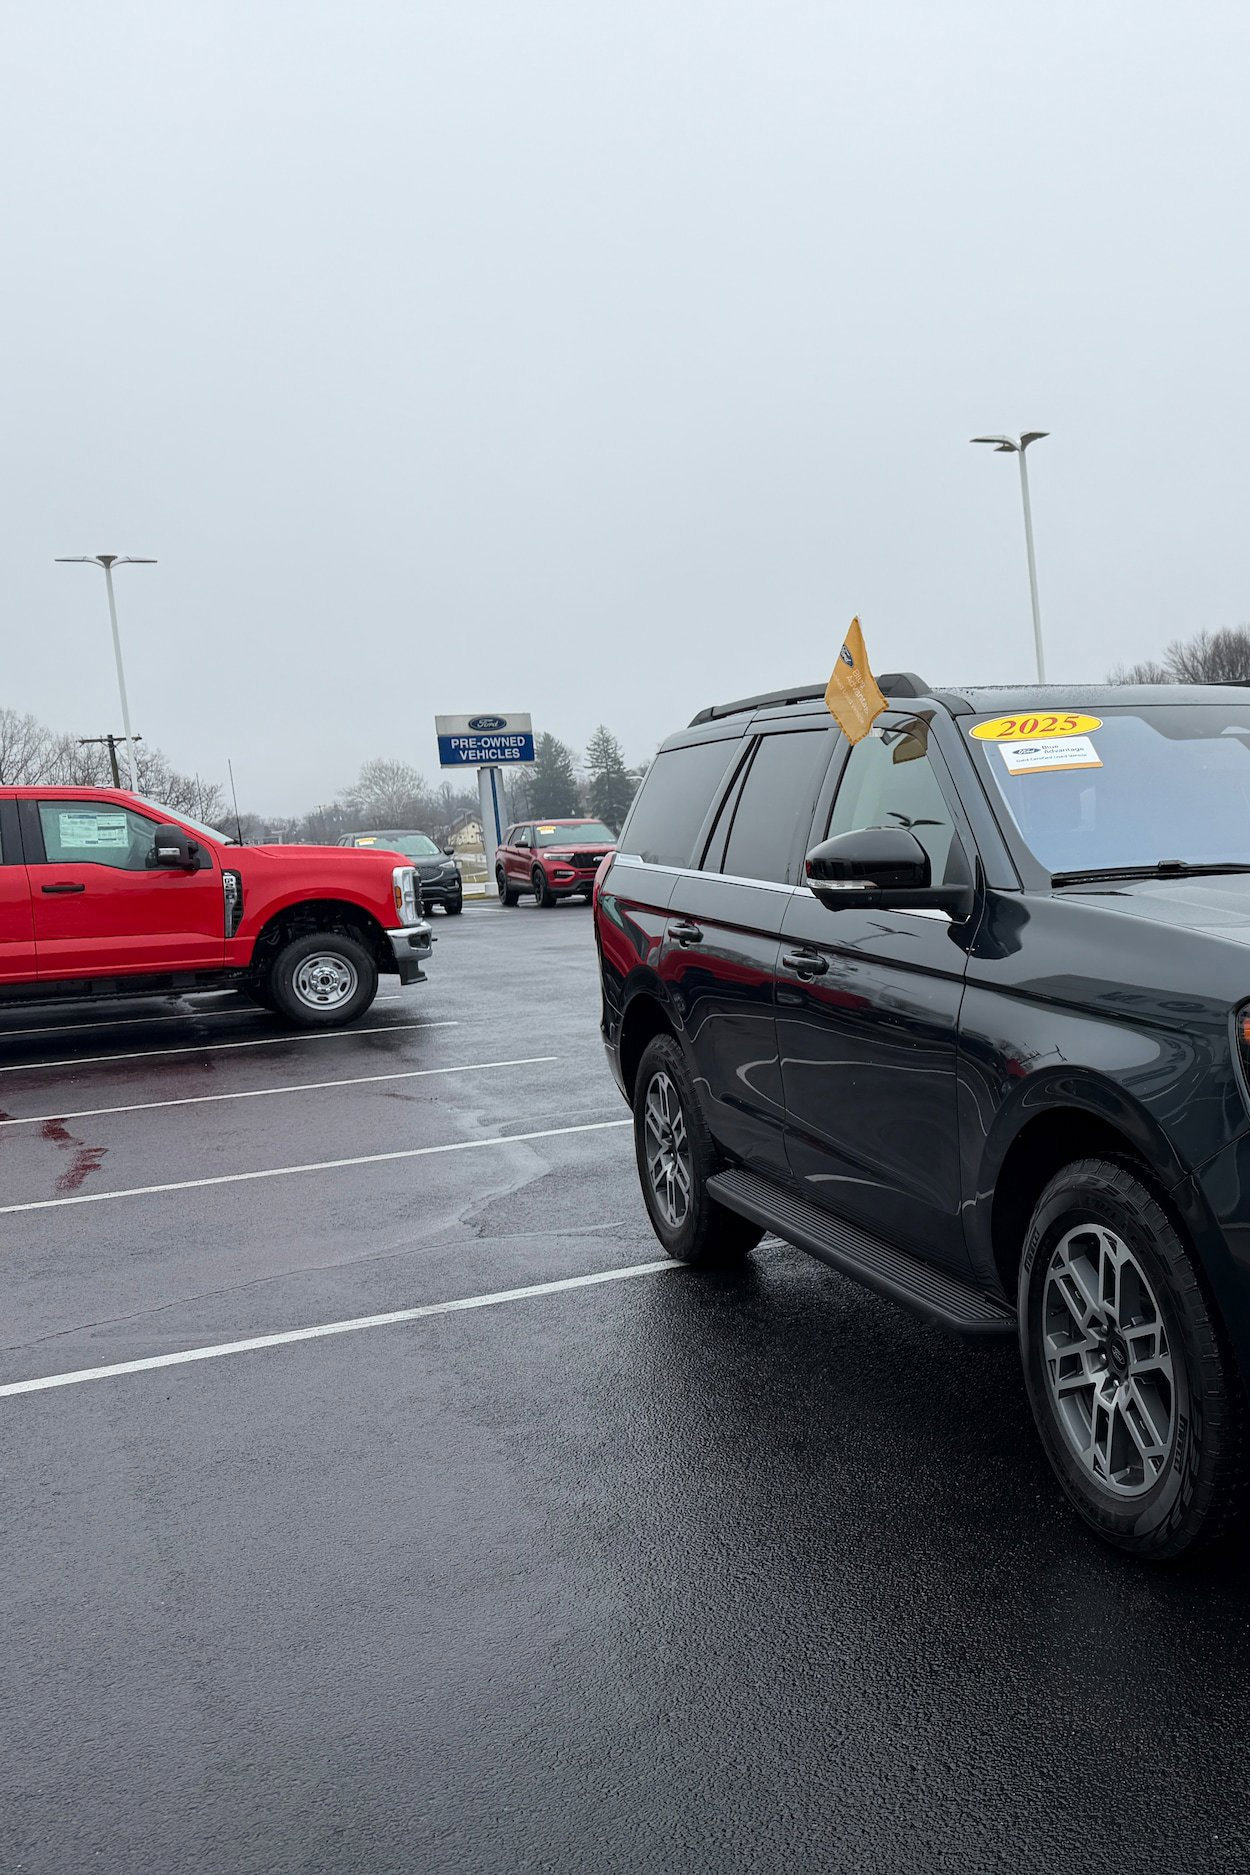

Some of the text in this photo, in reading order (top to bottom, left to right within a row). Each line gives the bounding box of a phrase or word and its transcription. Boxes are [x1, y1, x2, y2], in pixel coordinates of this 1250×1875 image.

[477, 719, 499, 728] Ford
[996, 715, 1080, 738] 2025
[450, 736, 525, 749] PRE-OWNED
[459, 748, 520, 761] VEHICLES
